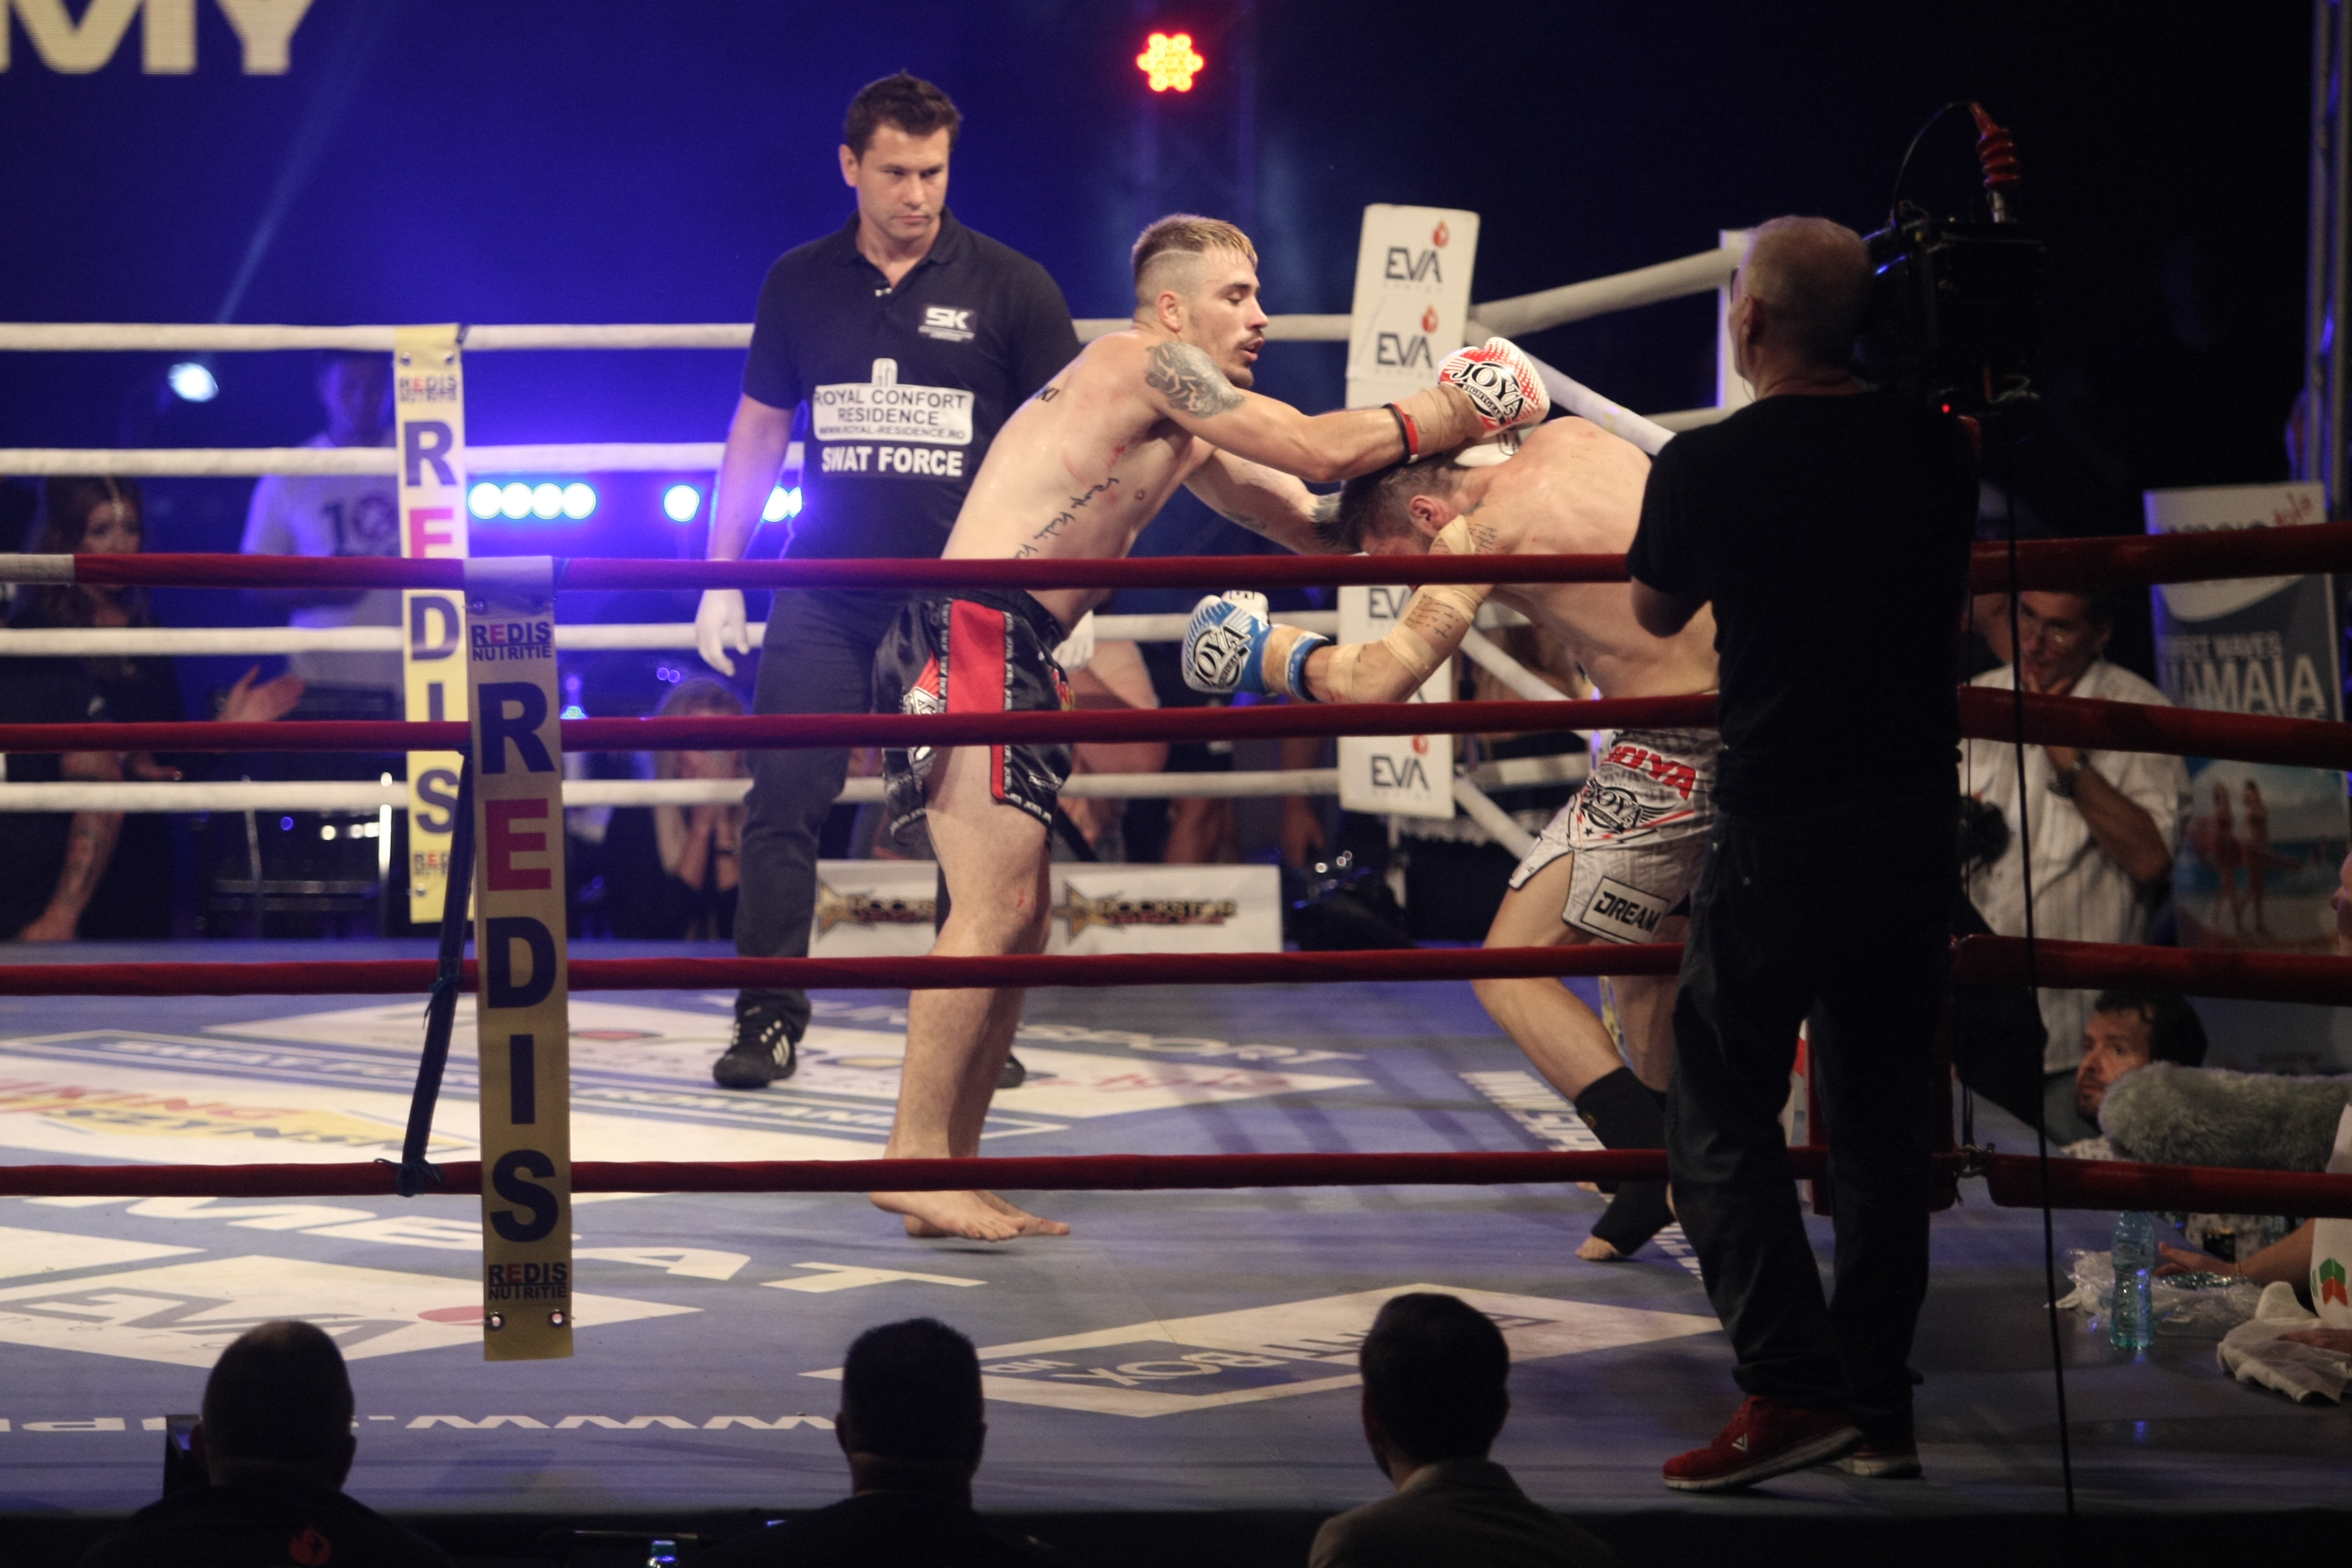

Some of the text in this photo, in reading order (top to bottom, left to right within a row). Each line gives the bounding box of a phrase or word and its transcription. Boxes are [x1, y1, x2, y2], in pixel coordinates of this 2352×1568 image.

[1385, 247, 1442, 283] EVA
[925, 307, 970, 330] SK
[1377, 333, 1433, 368] EVA
[814, 389, 967, 409] ROYAL CONFORT
[1451, 362, 1524, 420] JOYA
[838, 407, 939, 425] RESIDENCE
[822, 446, 964, 477] SWAT FORCE
[1368, 587, 1407, 619] EV
[471, 621, 552, 647] REDIS
[472, 644, 552, 661] NUTRITIE
[1370, 755, 1429, 791] EVA
[478, 681, 559, 1243] REDIS
[488, 1262, 568, 1285] REDIS
[489, 1284, 567, 1300] NUTRITIE
[1050, 1350, 1290, 1387] BOX
